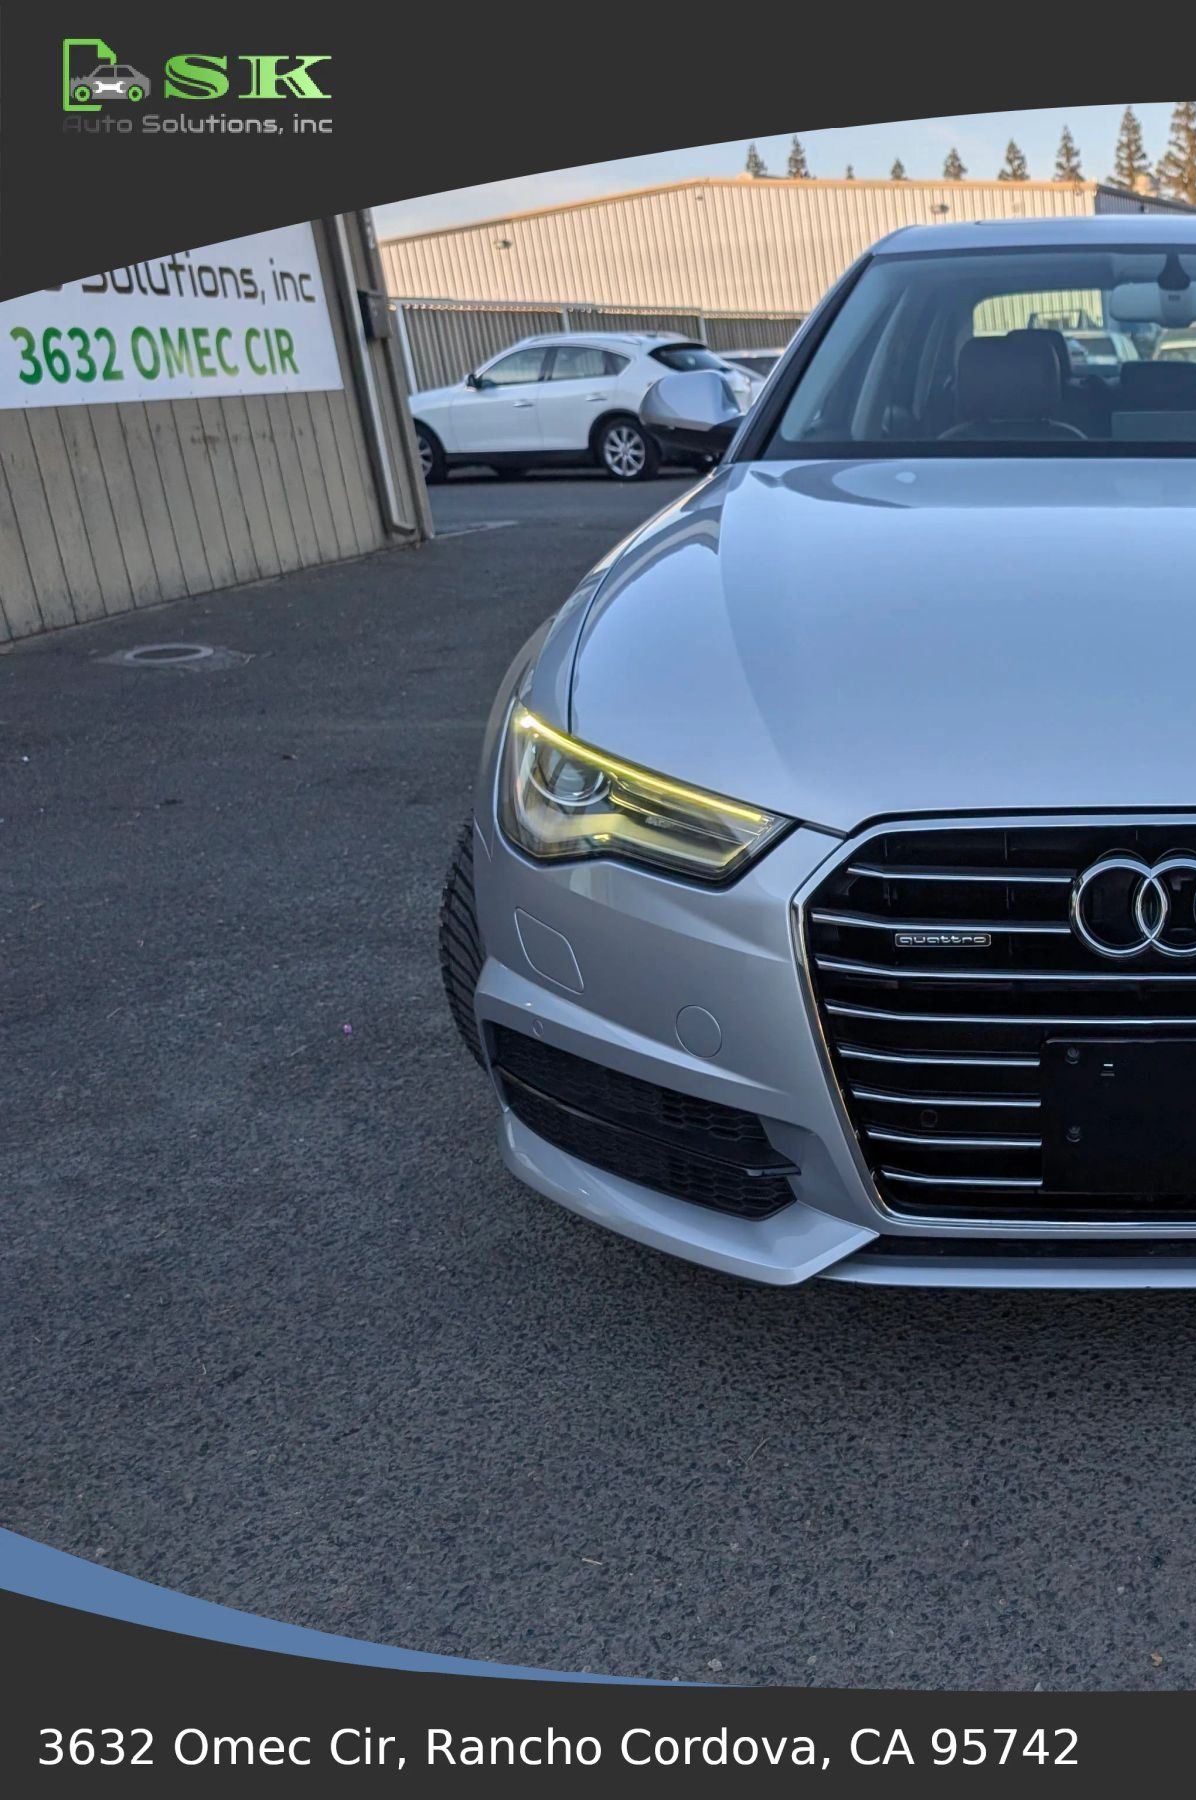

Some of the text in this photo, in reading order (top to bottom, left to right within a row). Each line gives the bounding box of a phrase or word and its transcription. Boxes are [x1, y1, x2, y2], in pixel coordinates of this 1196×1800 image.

[269, 257, 316, 303] inc
[9, 326, 300, 385] 3632 OMEC CIR
[899, 935, 987, 946] quattro
